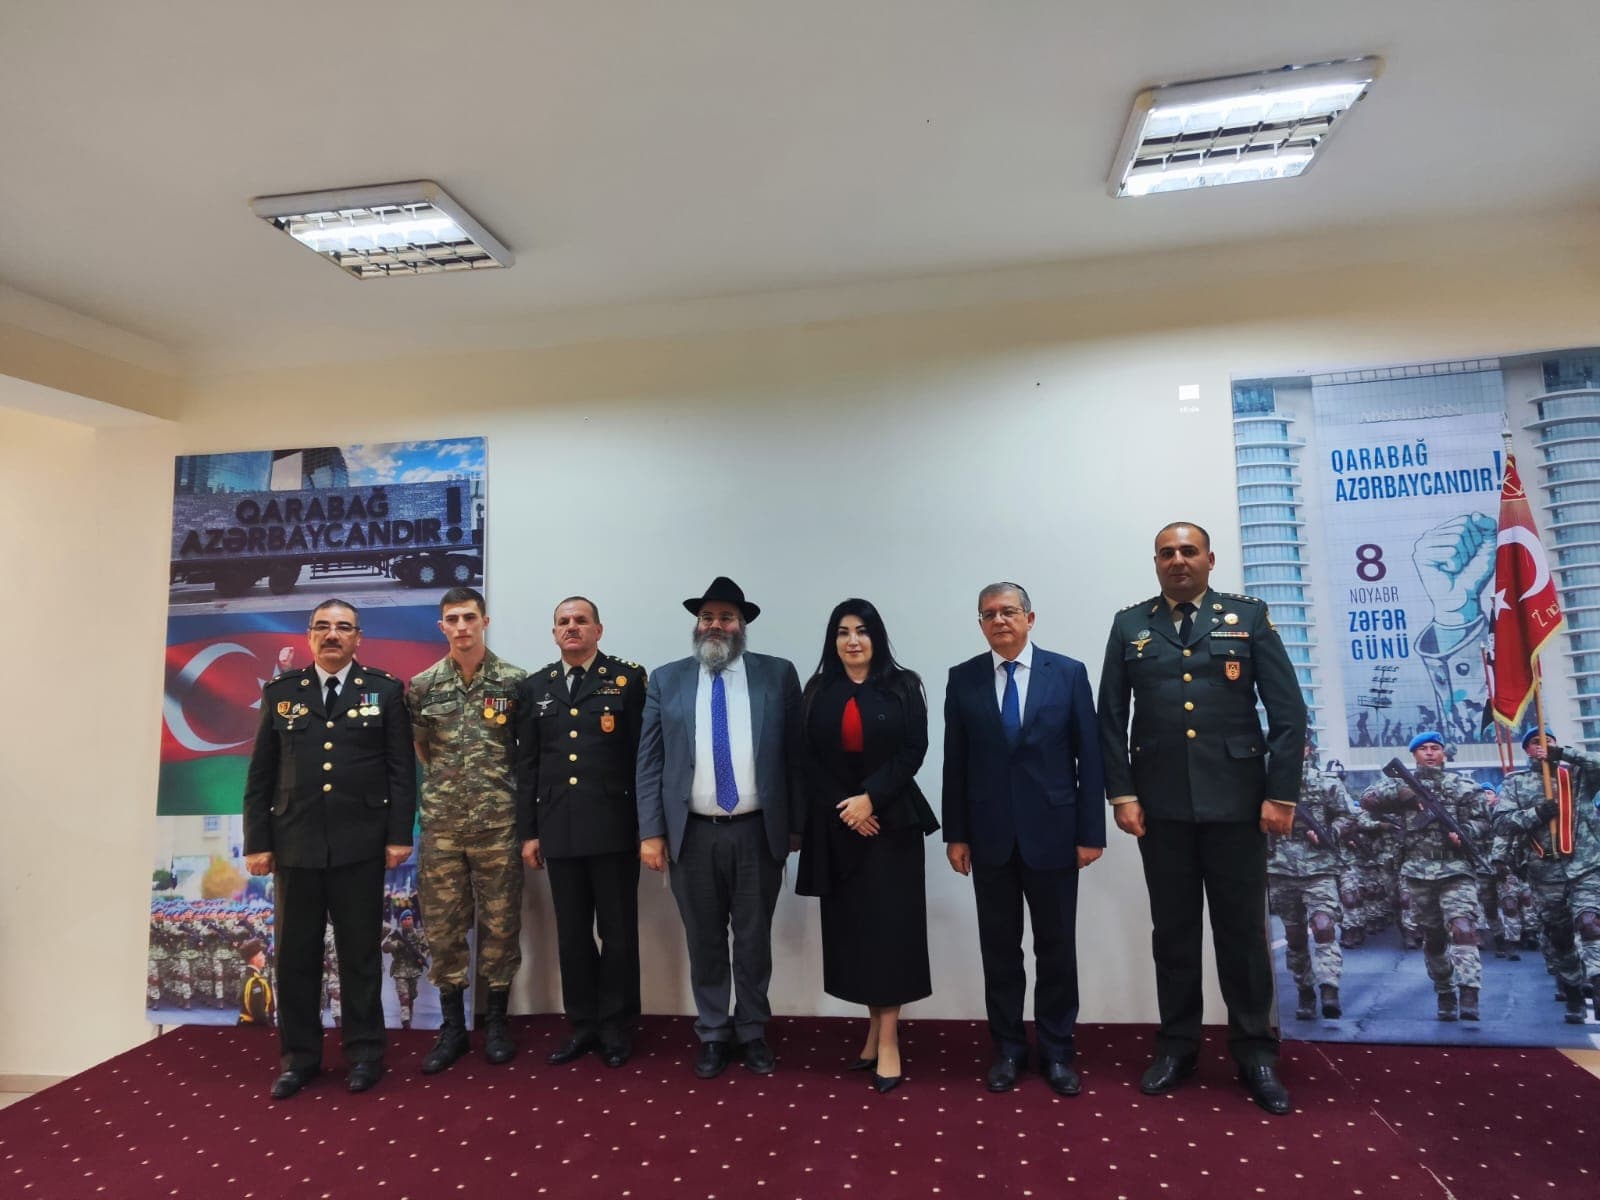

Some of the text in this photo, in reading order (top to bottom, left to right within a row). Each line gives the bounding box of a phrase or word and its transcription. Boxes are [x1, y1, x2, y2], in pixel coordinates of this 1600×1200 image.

[1331, 438, 1429, 475] QARABAĞ
[235, 487, 389, 525] QARABAĞ
[1356, 543, 1387, 582] 8
[1350, 586, 1399, 604] NOYABR
[1348, 608, 1407, 633] ZƏFƏR
[1351, 633, 1409, 660] GÜNÜ
